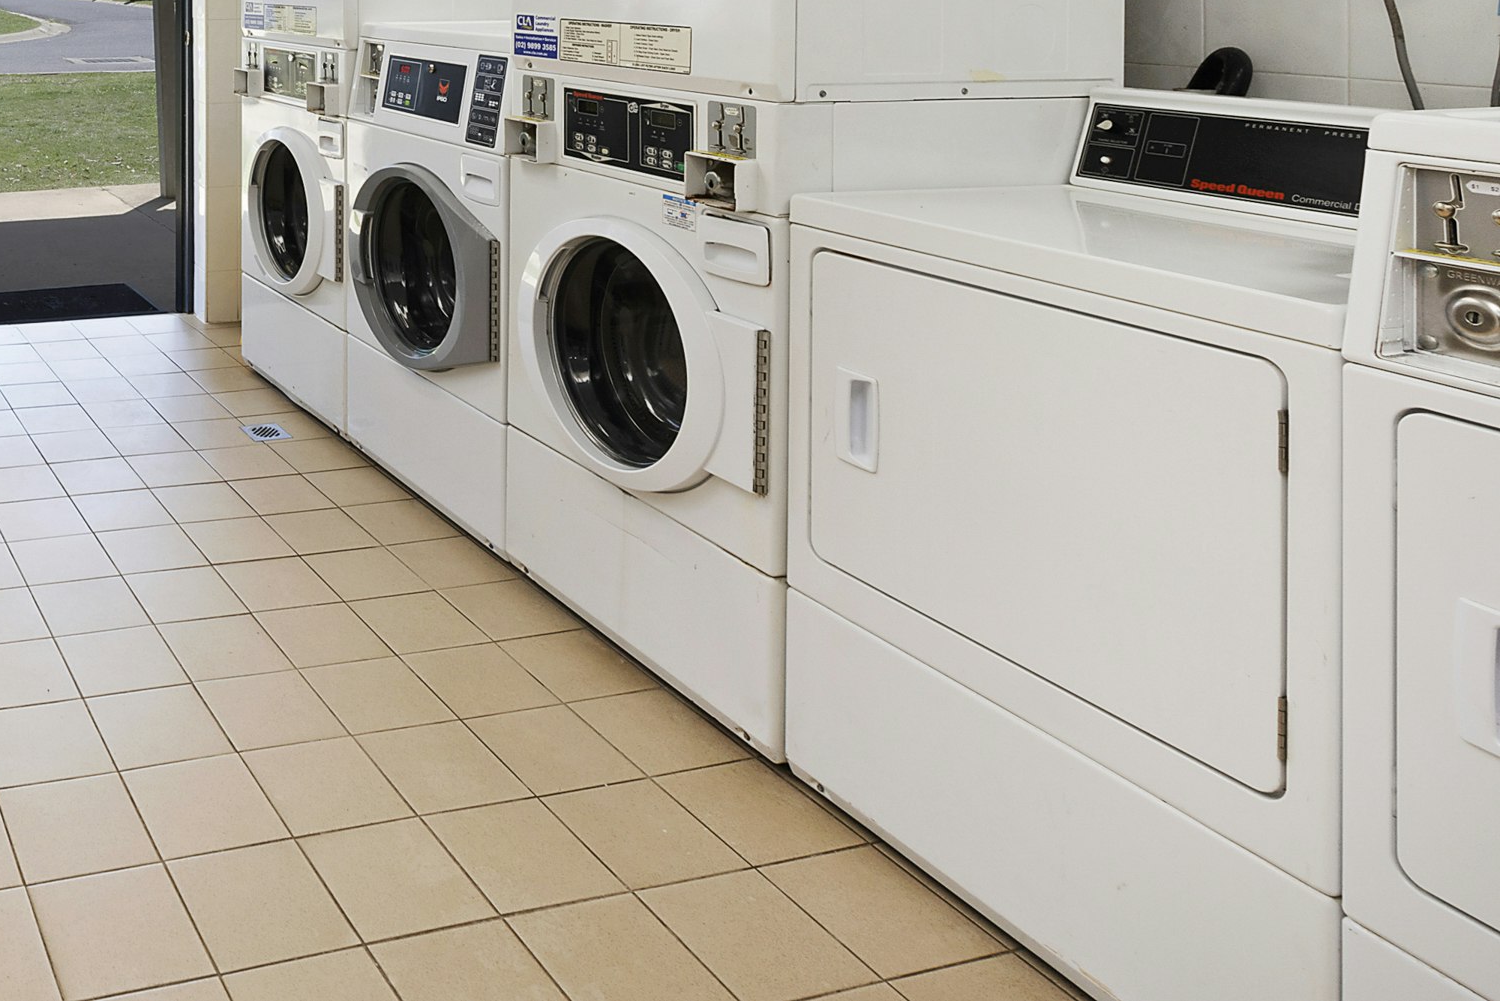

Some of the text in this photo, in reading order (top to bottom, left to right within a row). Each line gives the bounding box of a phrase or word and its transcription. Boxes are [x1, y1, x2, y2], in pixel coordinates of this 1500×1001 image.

[517, 15, 532, 26] CLA
[1244, 122, 1362, 139] PERMANENT PRESS
[1190, 178, 1236, 194] Speed
[1237, 184, 1285, 200] Queen
[1291, 193, 1352, 210] Commercial
